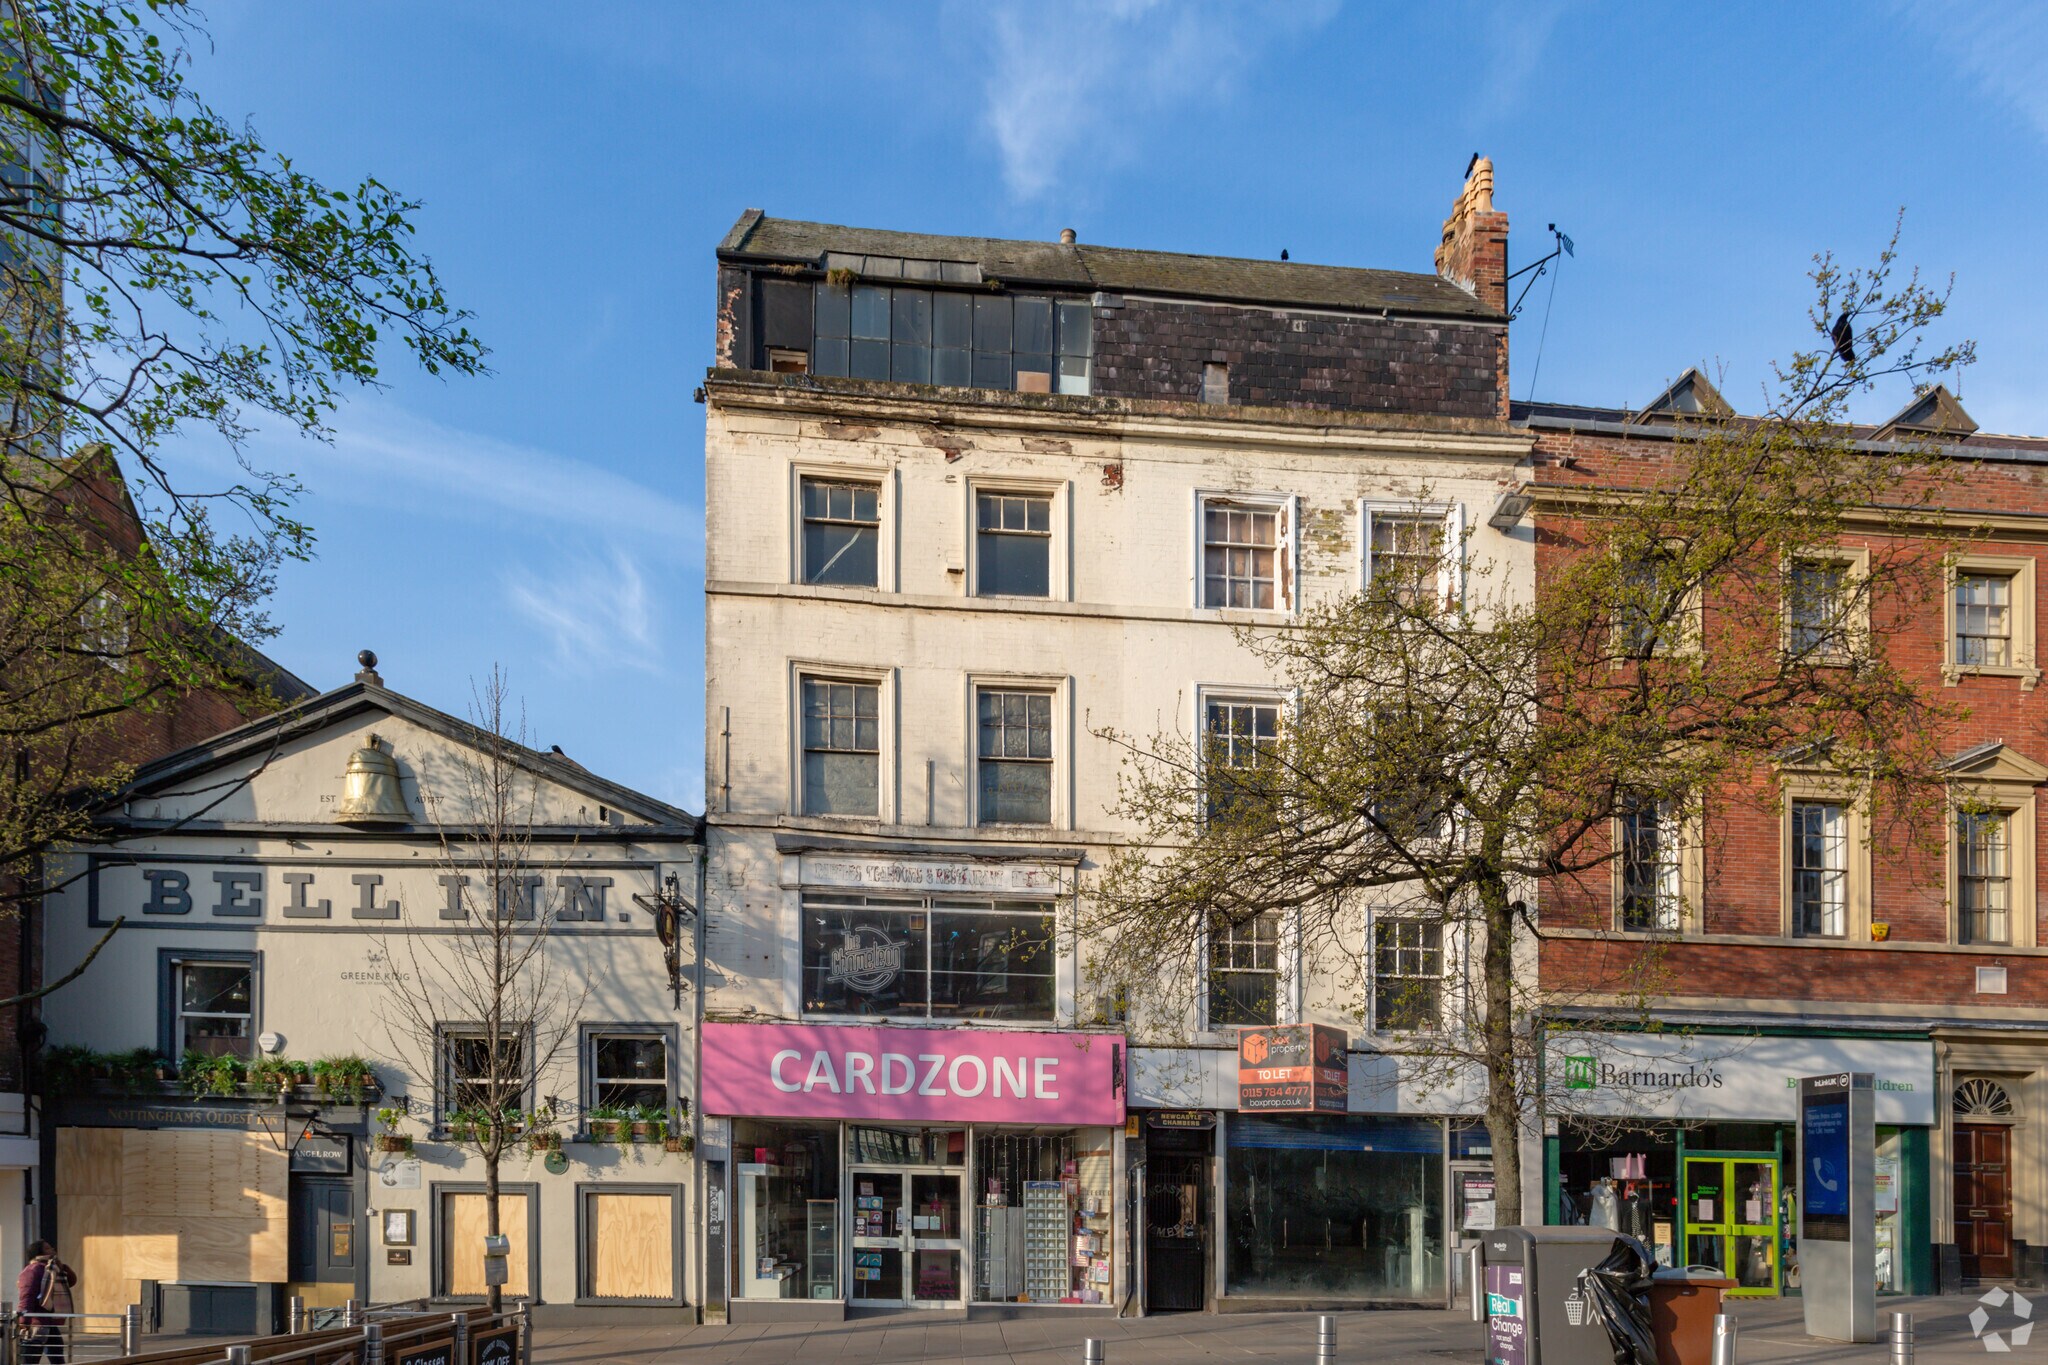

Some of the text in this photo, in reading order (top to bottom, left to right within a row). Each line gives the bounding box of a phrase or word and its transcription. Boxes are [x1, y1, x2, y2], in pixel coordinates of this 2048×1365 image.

[320, 795, 336, 803] EST
[143, 868, 399, 920] BELL
[841, 931, 861, 951] The
[831, 941, 901, 976] Chameleon
[340, 972, 410, 980] GREENE KING
[770, 1049, 1059, 1100] CARDZONE
[1257, 1069, 1292, 1080] TO LET
[1601, 1063, 1723, 1089] Barnardo's
[1242, 1088, 1263, 1098] 0115
[1264, 1087, 1283, 1097] 784
[1285, 1086, 1309, 1097] 4777
[1249, 1098, 1302, 1108] boxprop.co.uk
[1160, 1113, 1202, 1121] NEWCASTLE
[293, 1150, 344, 1159] ANGEL ROW
[1491, 1297, 1511, 1314] Real
[1491, 1317, 1523, 1338] Change
